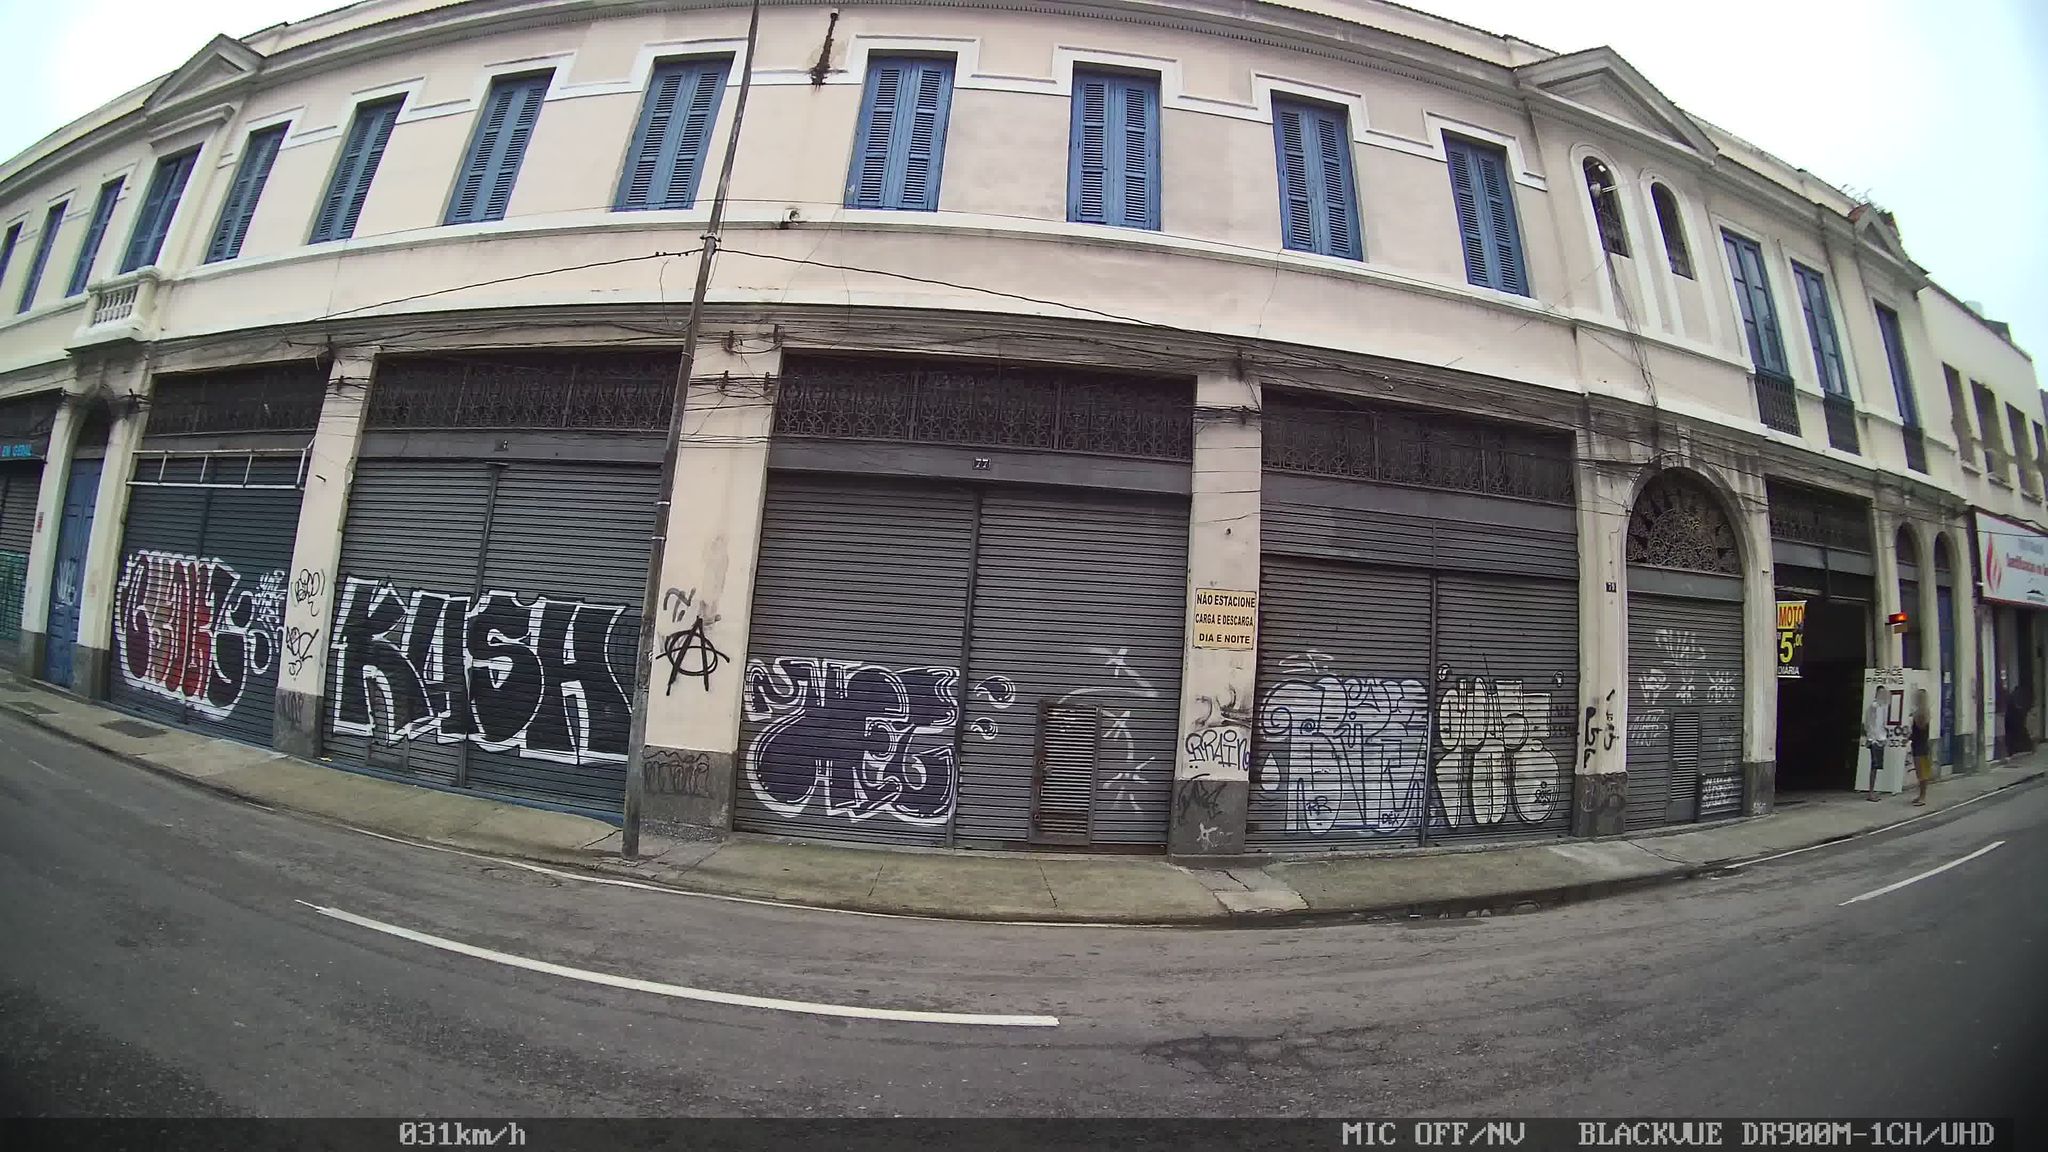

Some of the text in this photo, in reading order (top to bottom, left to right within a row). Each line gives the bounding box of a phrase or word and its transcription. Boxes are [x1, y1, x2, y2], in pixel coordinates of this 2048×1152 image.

[975, 458, 989, 468] 77
[1197, 592, 1256, 608] NÃO ESTACIONE
[1195, 613, 1254, 627] CARGA E DESCARGA
[1778, 605, 1804, 627] MOTO
[1199, 633, 1251, 644] DIA E NOITE
